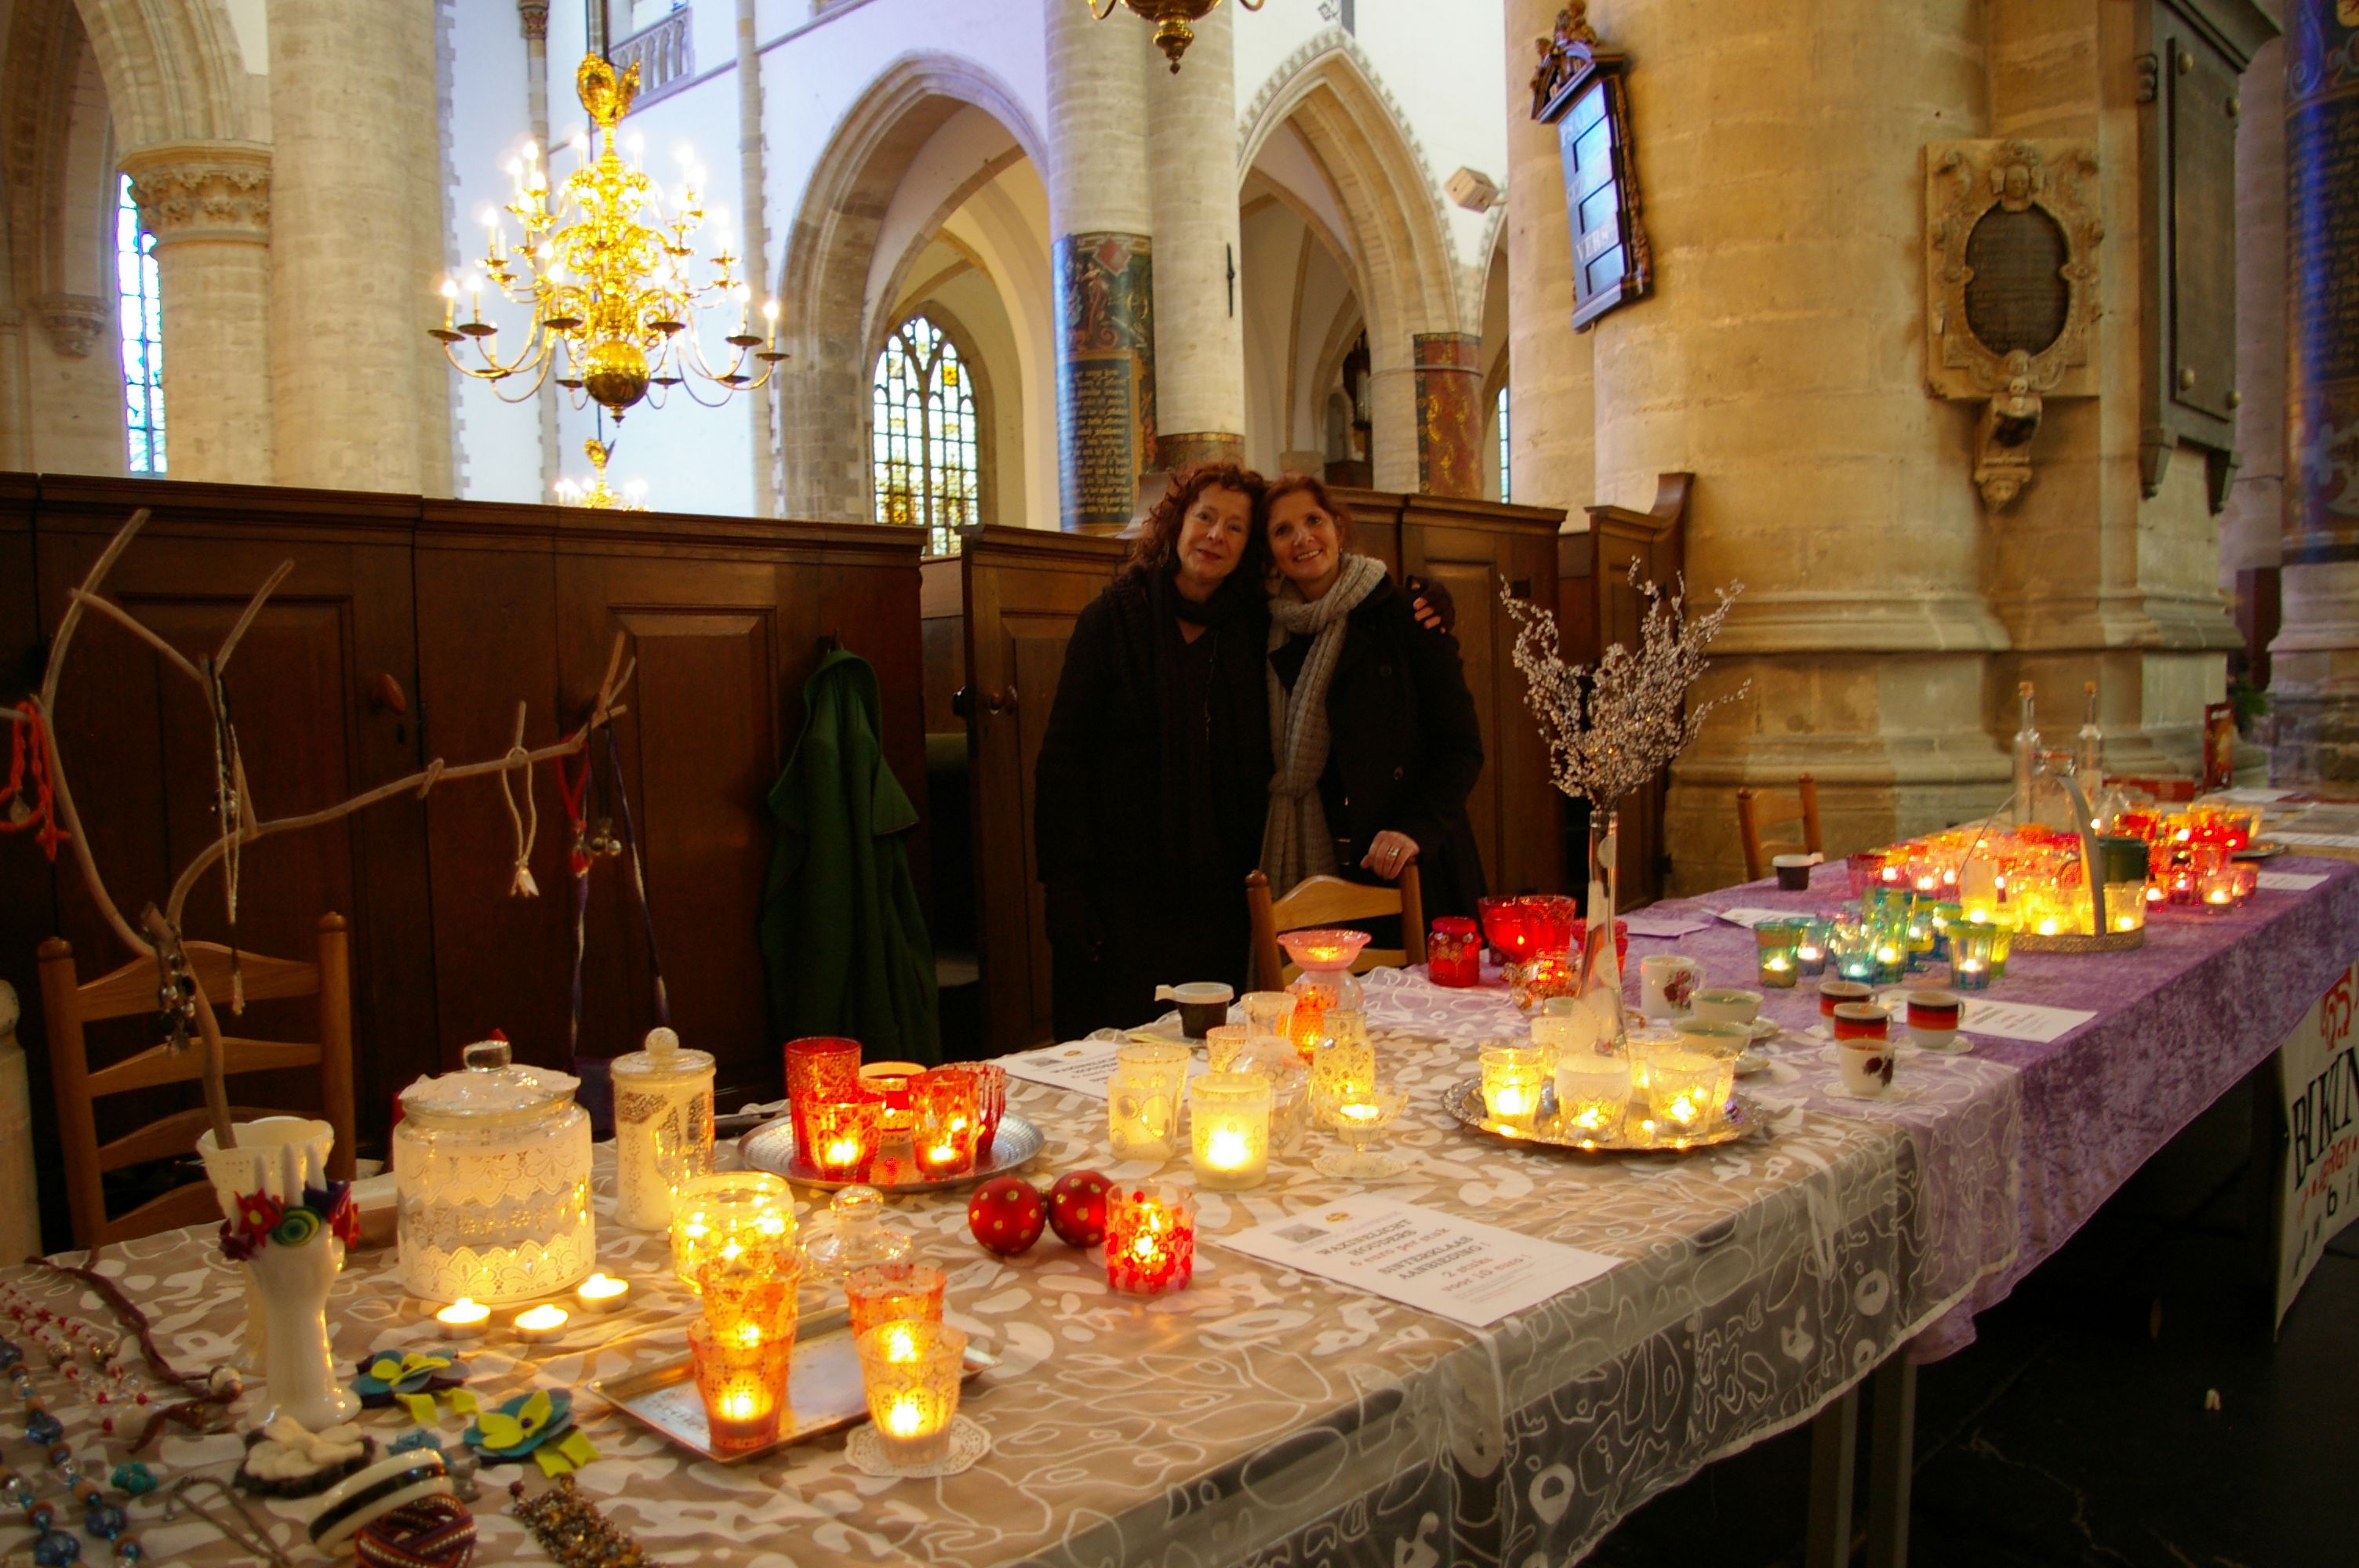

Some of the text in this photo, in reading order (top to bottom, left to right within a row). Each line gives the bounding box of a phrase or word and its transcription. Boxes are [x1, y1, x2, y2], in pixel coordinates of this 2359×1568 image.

[1576, 226, 1608, 262] VERS
[1364, 1249, 1394, 1263] euro
[1397, 1240, 1418, 1251] per
[1440, 1277, 1473, 1292] voor
